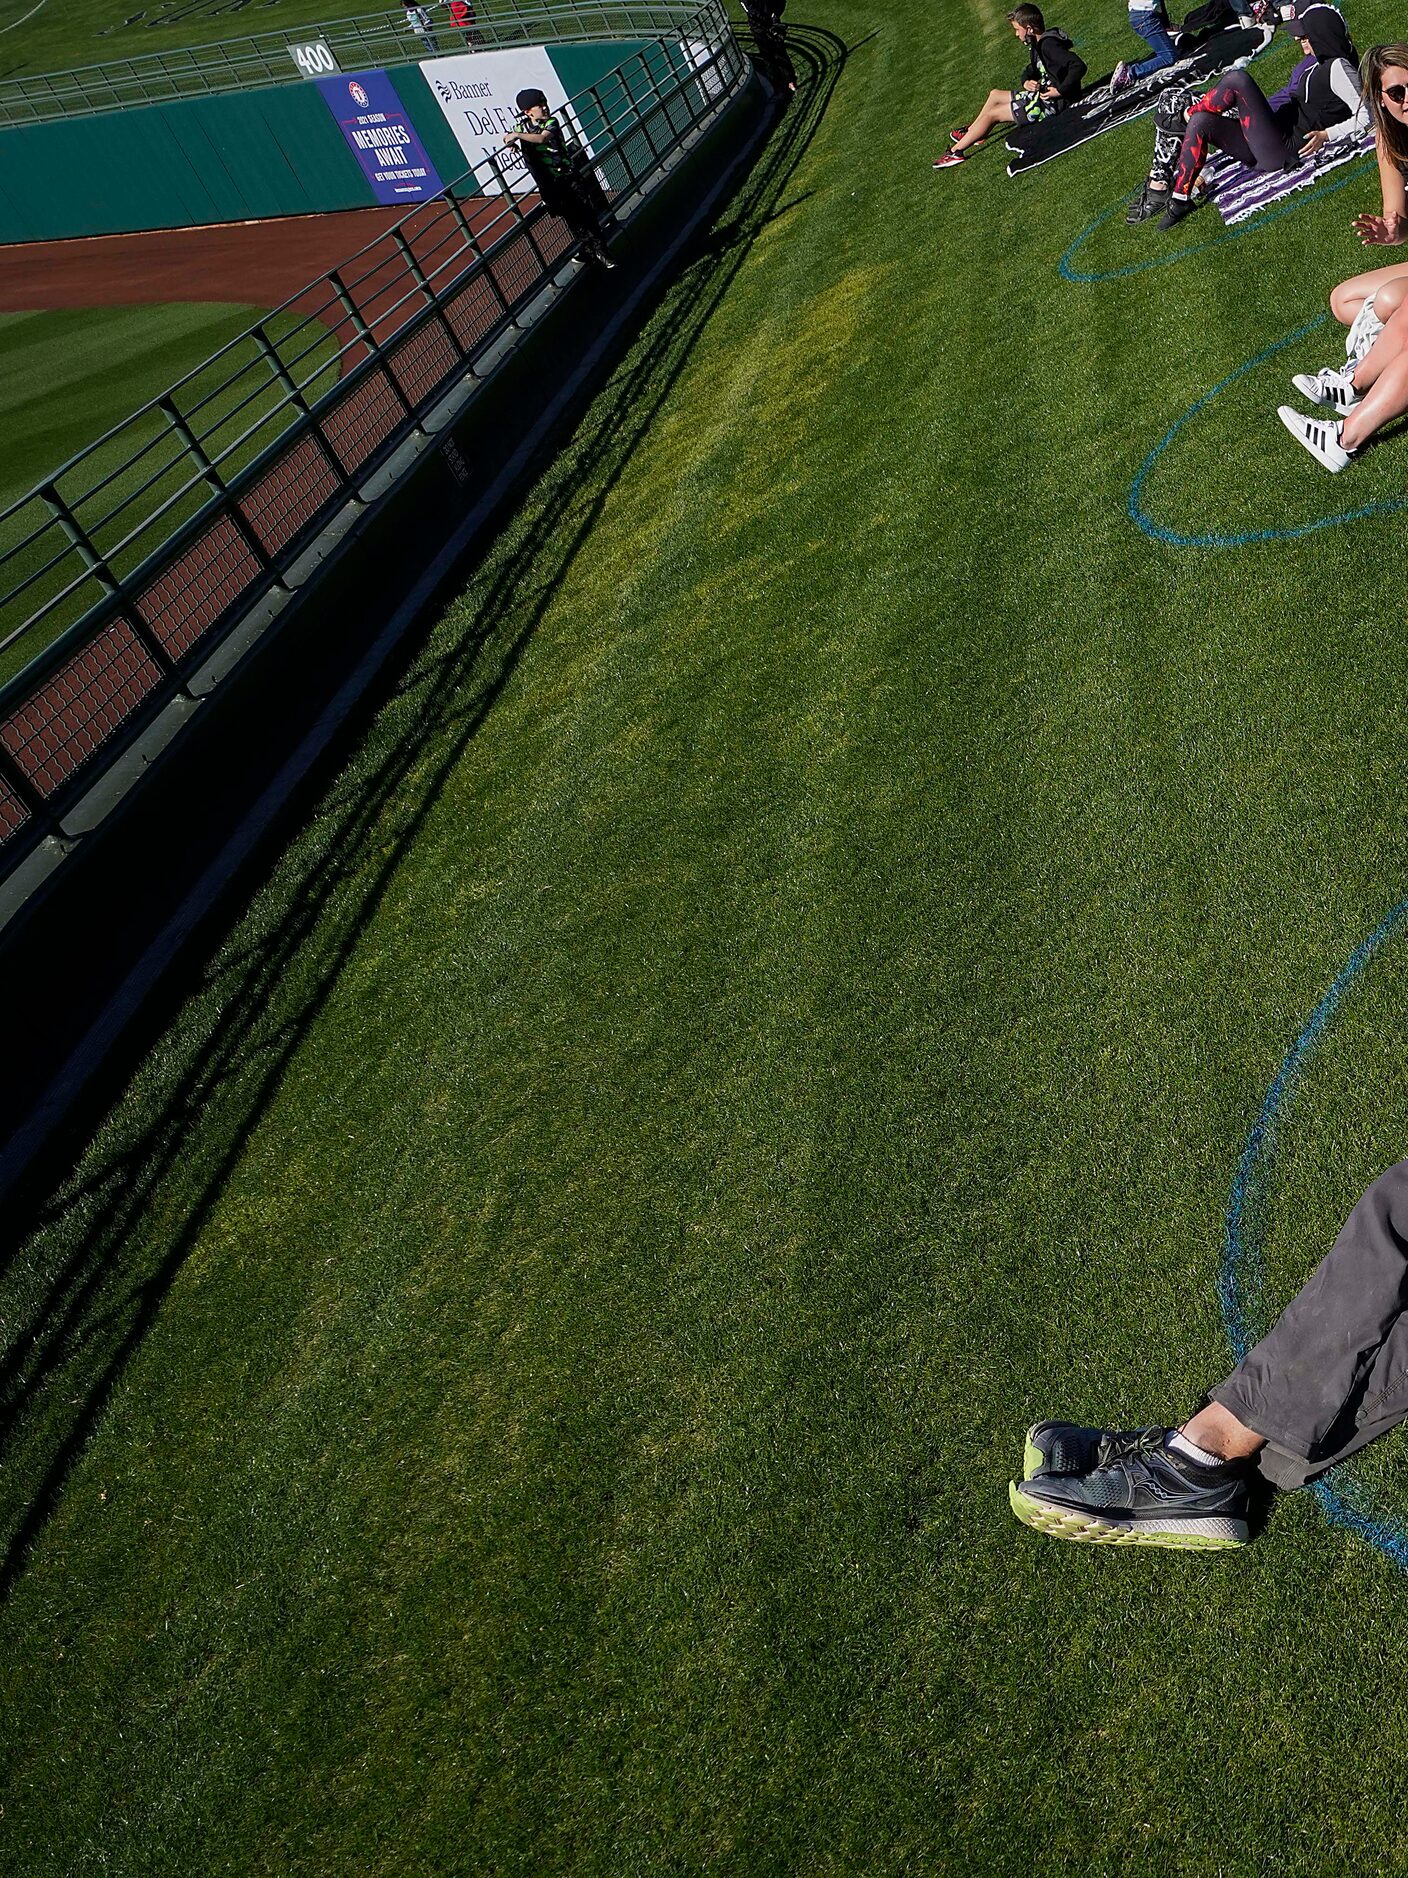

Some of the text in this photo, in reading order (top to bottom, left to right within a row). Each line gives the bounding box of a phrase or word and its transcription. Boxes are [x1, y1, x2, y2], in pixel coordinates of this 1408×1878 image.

[297, 44, 334, 74] 400
[449, 81, 493, 100] Banner
[464, 108, 499, 136] Del
[352, 126, 410, 149] MEMORIES
[375, 147, 408, 167] AWAIT
